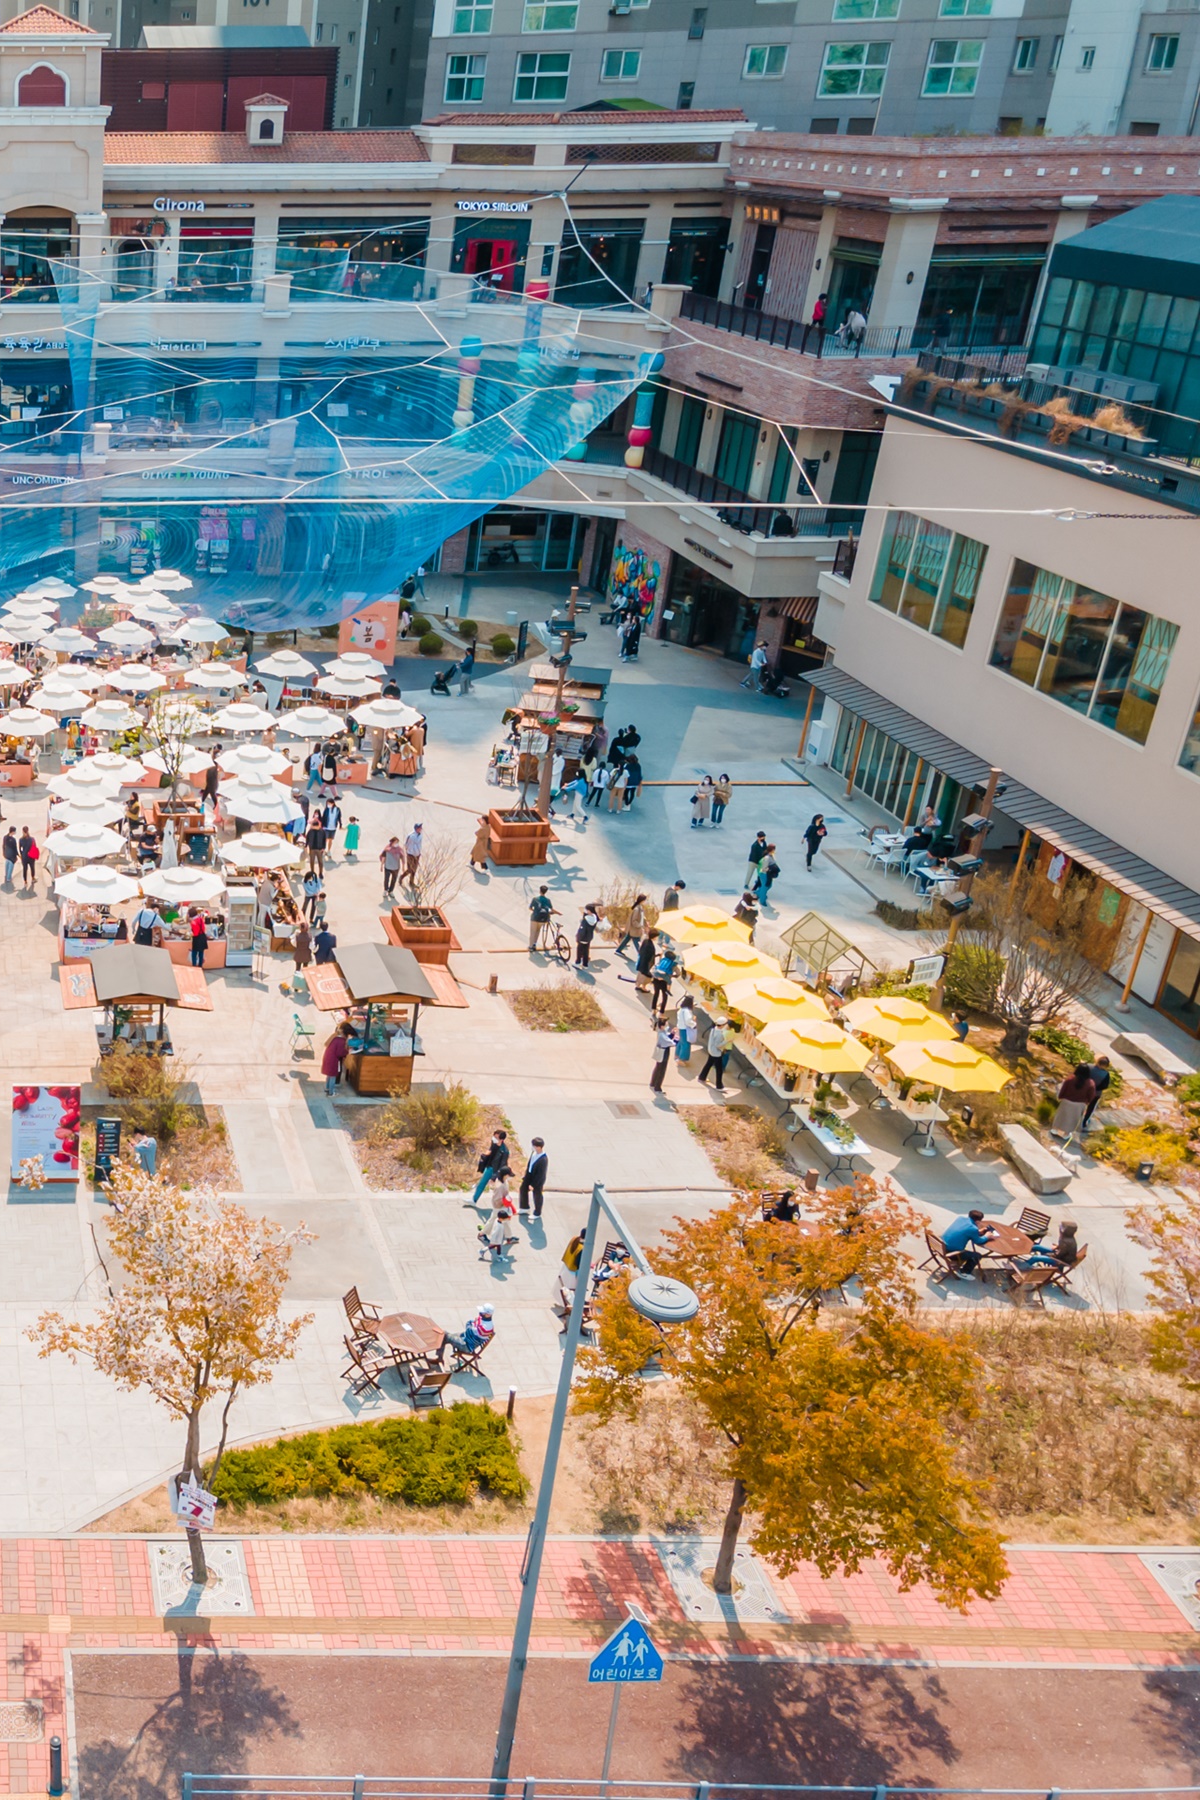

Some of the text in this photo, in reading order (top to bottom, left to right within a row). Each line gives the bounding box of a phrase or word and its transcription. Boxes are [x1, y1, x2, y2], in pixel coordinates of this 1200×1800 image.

[457, 201, 528, 212] TOKYO SIRLOIN
[324, 336, 380, 351] 스시덴고쿠
[141, 471, 230, 480] OLIVE YOUNG
[592, 1667, 658, 1681] 어린이보호
